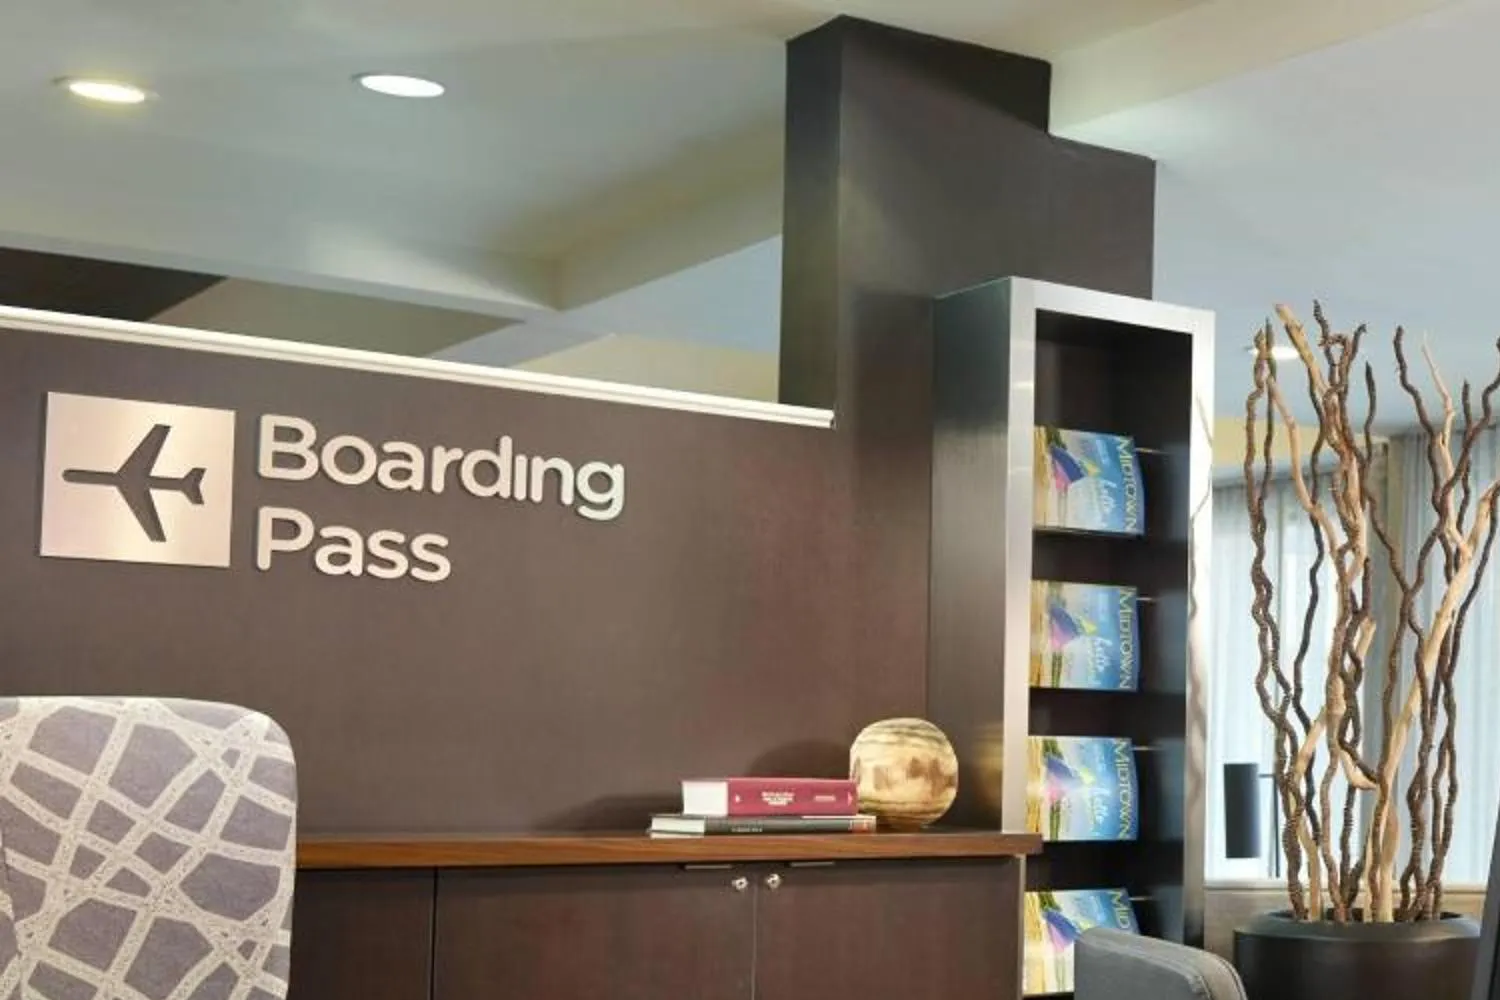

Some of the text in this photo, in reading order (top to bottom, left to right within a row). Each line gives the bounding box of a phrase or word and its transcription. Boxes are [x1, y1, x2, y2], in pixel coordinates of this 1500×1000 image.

[258, 414, 625, 521] Boarding
[1116, 436, 1137, 531] MIDTOWN
[257, 507, 452, 582] Pass
[1118, 588, 1135, 689] MIDTOWN
[1114, 740, 1132, 838] MIDTOWN
